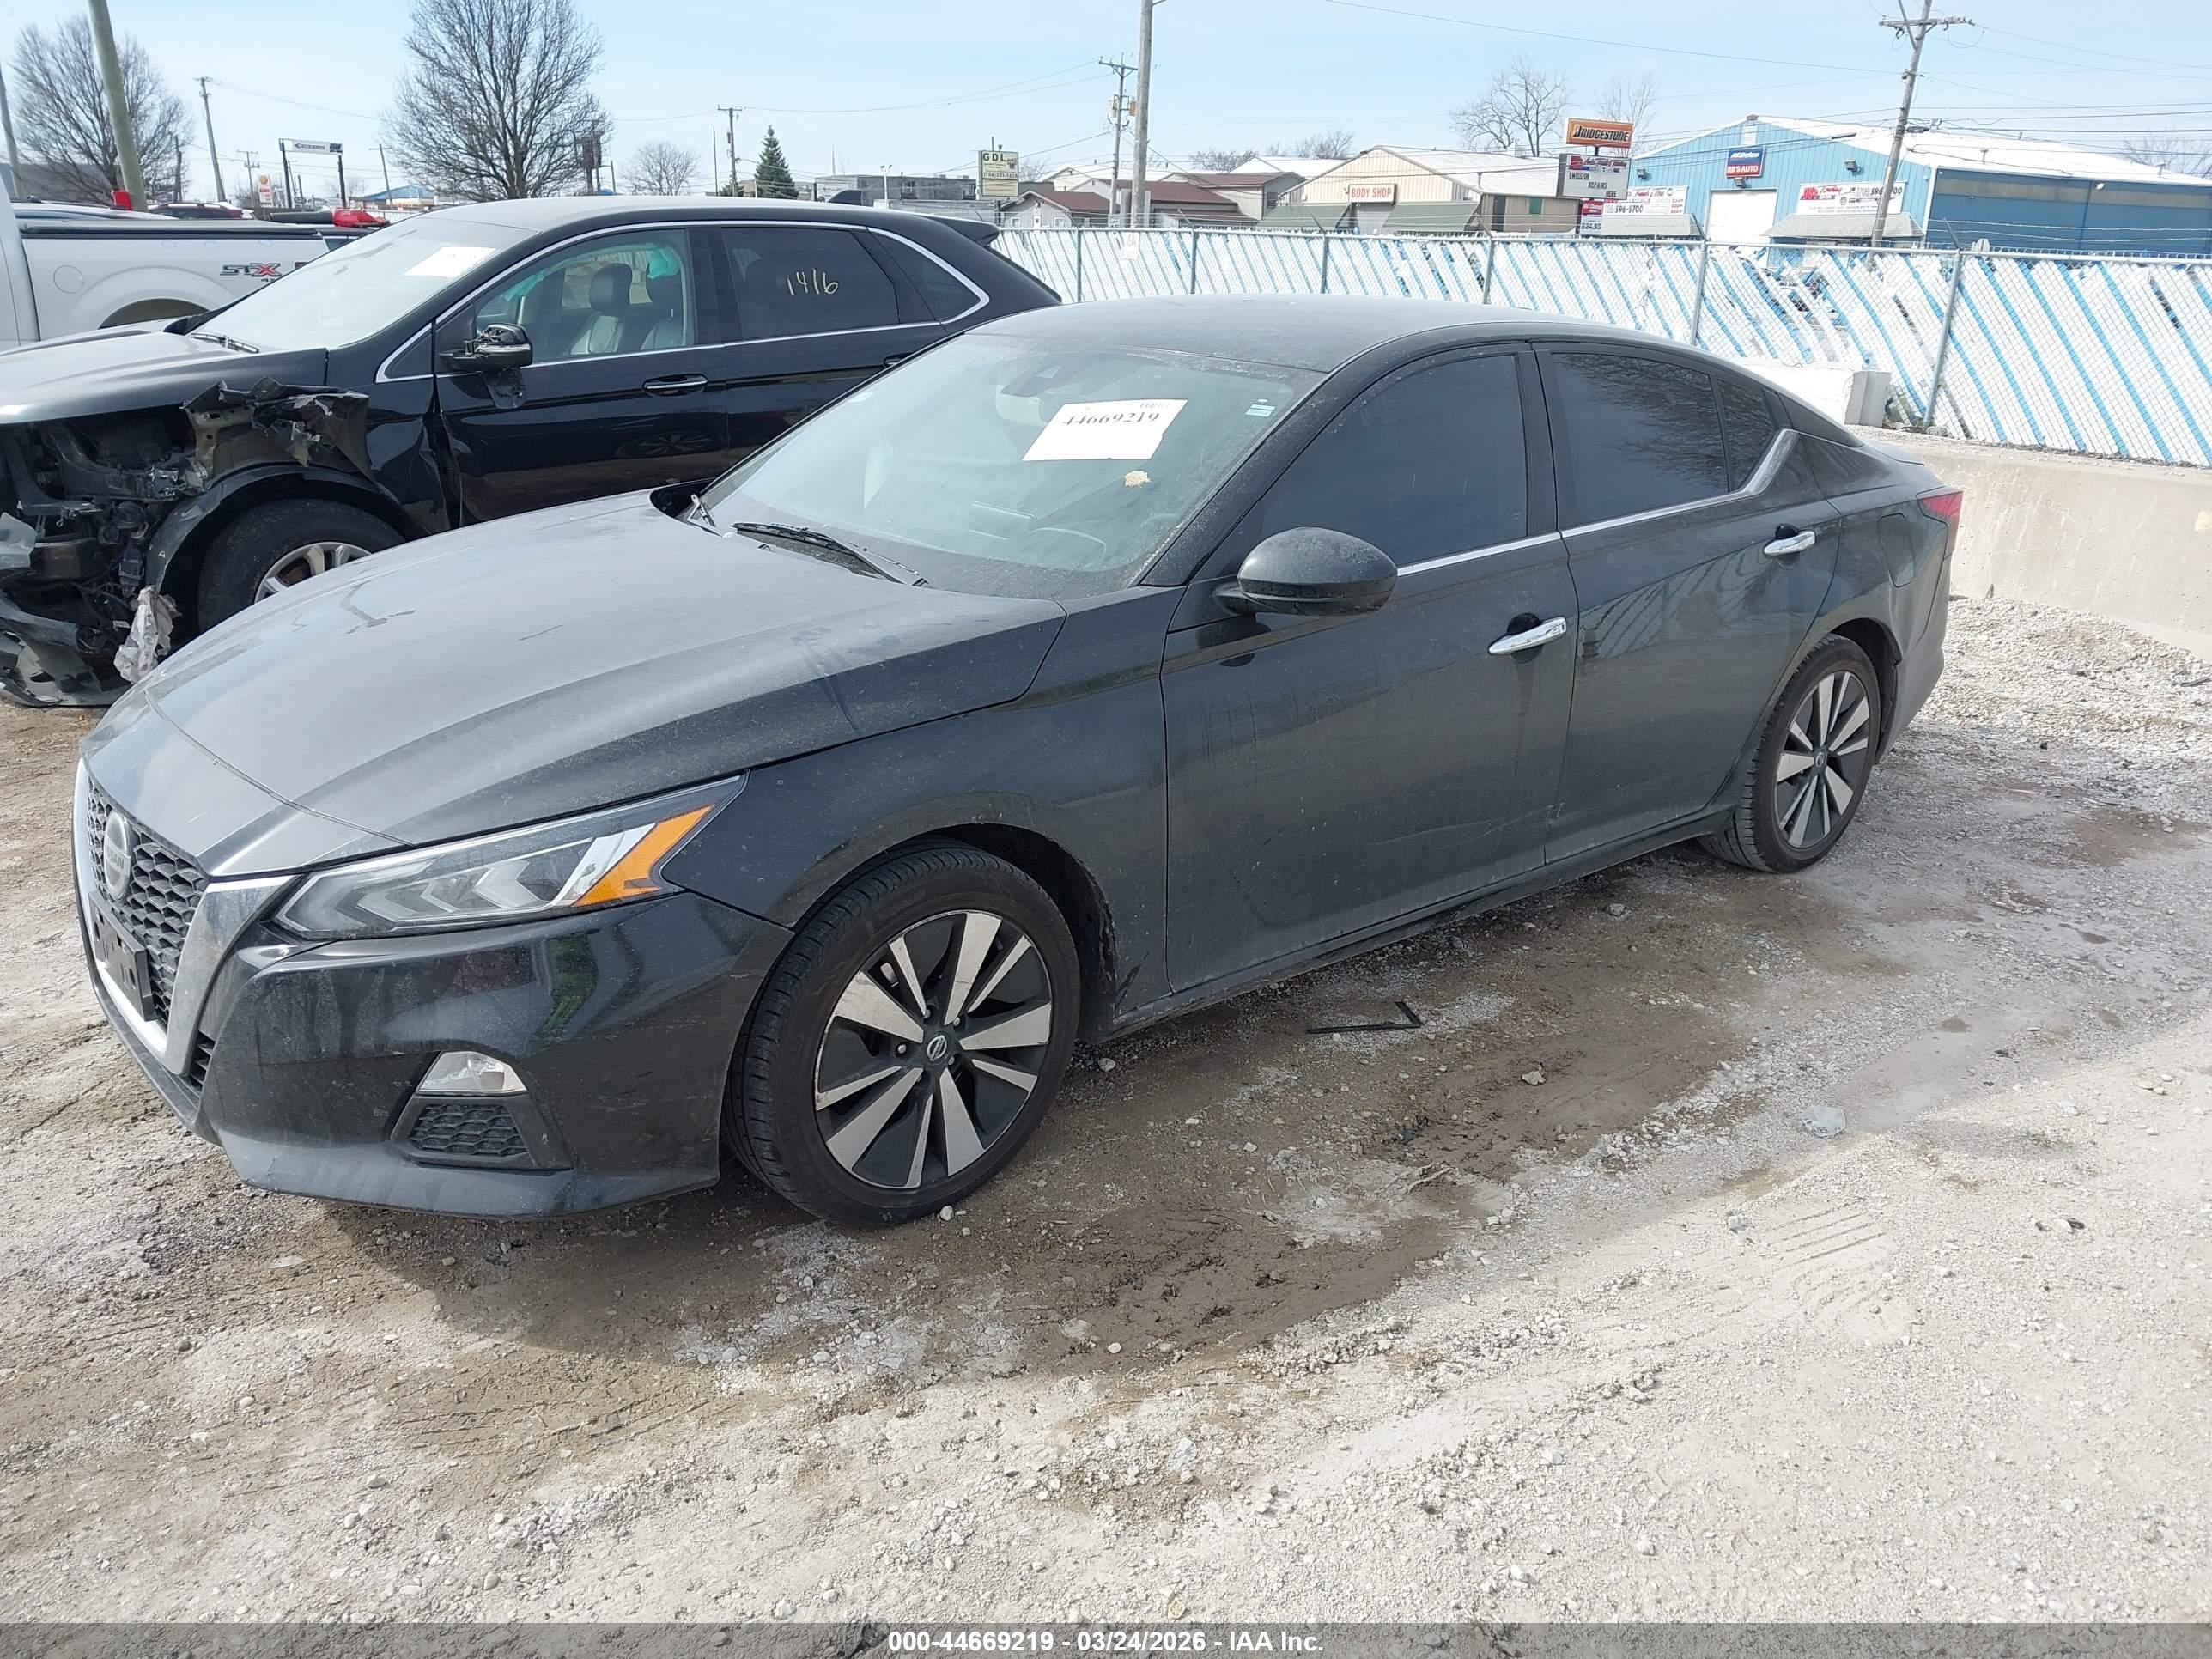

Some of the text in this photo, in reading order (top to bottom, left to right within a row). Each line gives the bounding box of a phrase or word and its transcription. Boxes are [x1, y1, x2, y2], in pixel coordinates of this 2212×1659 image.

[1573, 125, 1630, 142] BRIDGESTONE
[1569, 172, 1589, 180] EMISSION
[1351, 187, 1392, 198] BODY SHOP
[1614, 204, 1644, 214] 596-5700
[787, 268, 839, 296] 1416
[1061, 411, 1160, 426] 44669219
